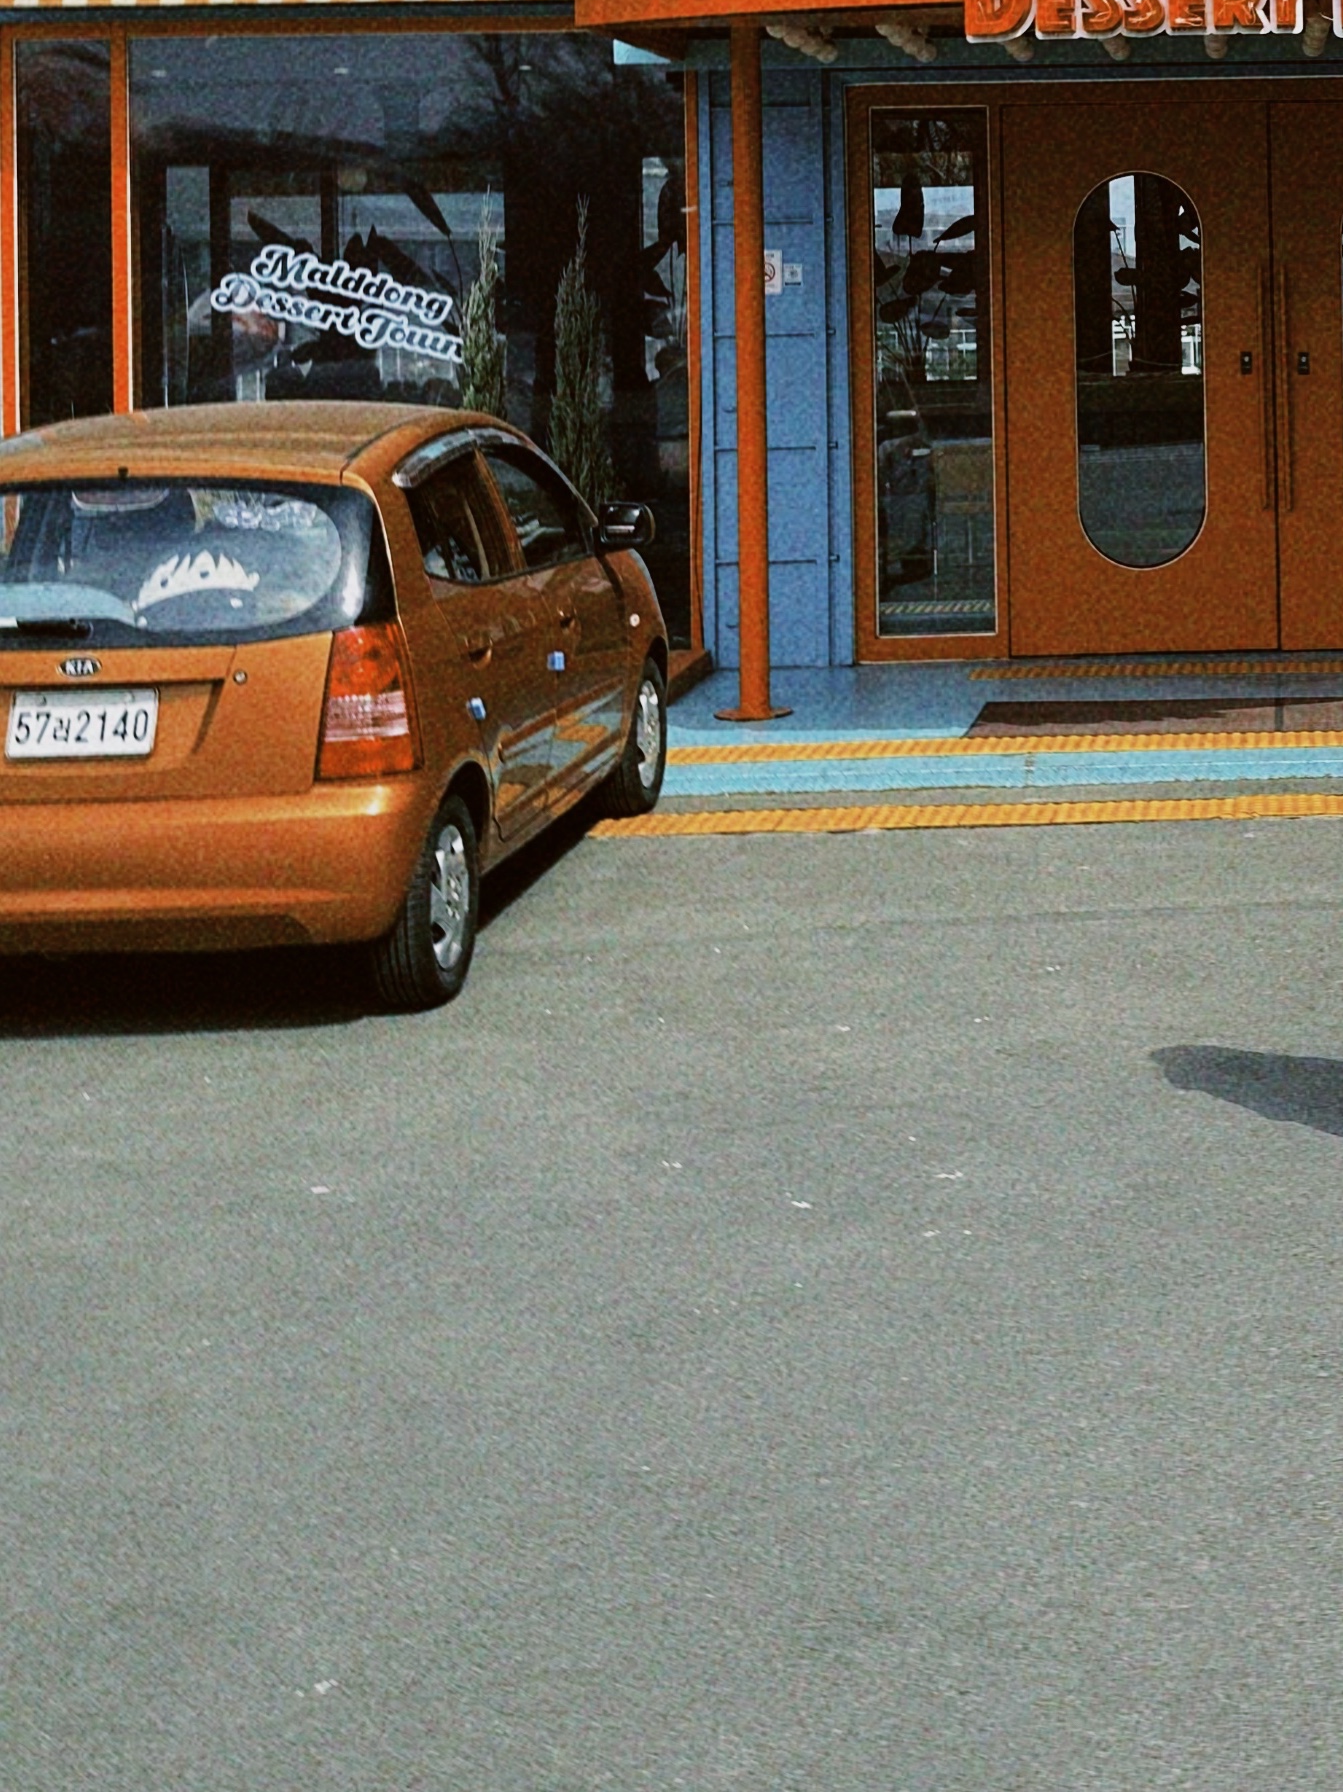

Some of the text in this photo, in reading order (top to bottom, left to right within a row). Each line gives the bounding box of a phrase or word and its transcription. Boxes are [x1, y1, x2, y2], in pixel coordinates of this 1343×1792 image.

[210, 273, 359, 336] Dessert
[250, 244, 453, 326] Malddong
[64, 659, 95, 676] KIA
